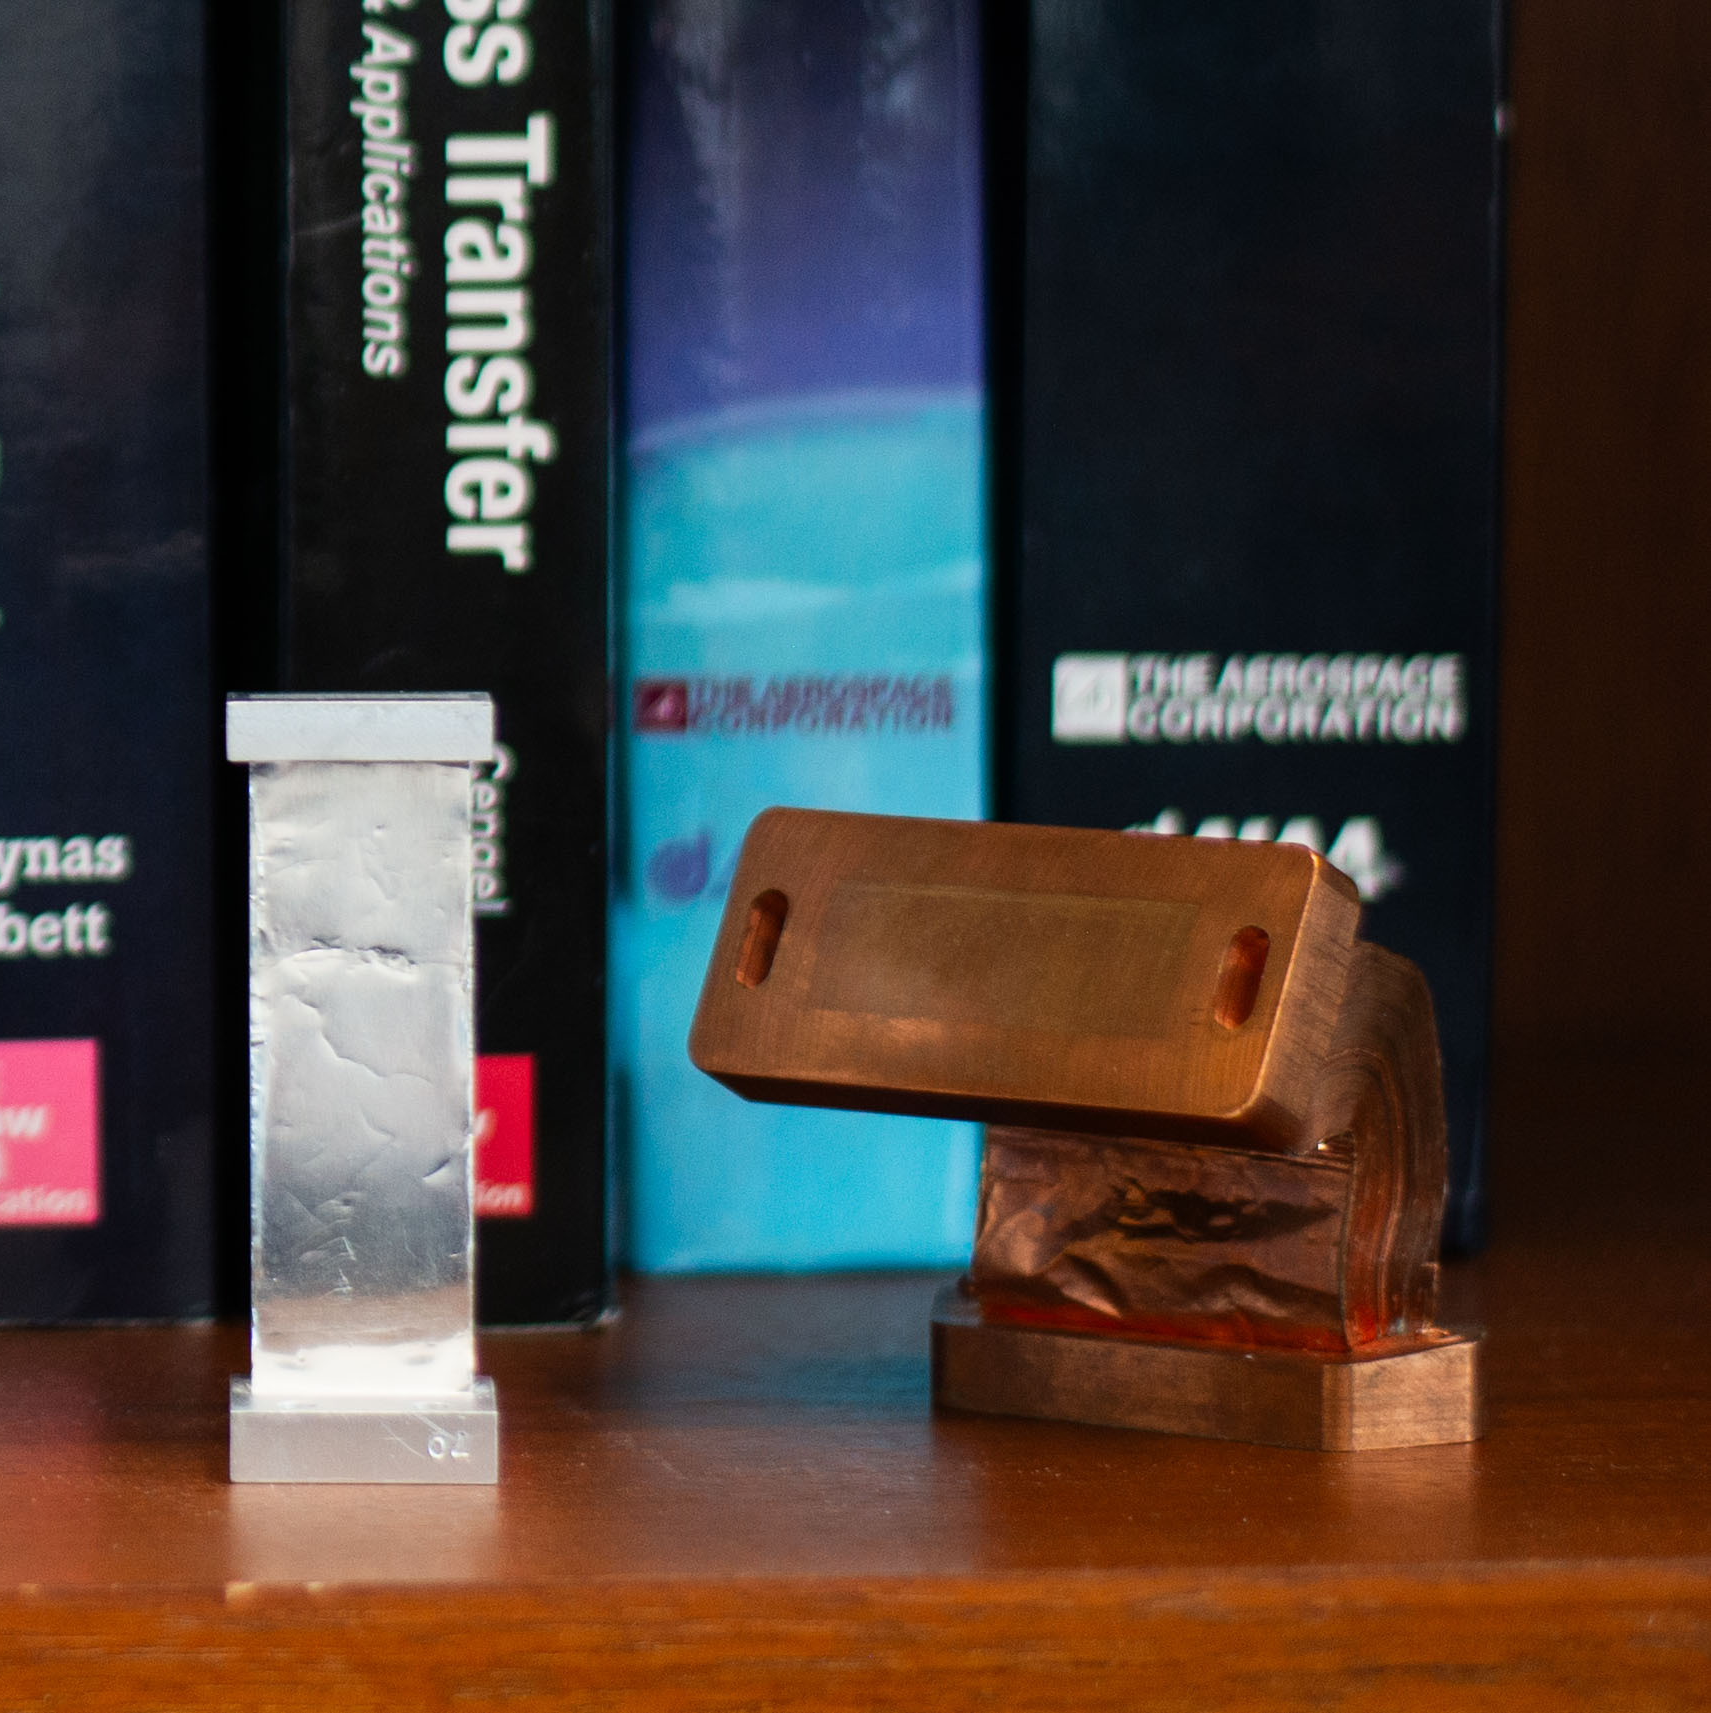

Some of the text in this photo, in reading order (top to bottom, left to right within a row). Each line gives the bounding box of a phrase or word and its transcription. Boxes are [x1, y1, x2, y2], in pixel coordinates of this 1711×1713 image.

[351, 24, 413, 377] Applications
[444, 114, 558, 572] Transfer
[1128, 697, 1464, 743] CORPORATION
[1129, 652, 1465, 695] THE AEROSPACE
